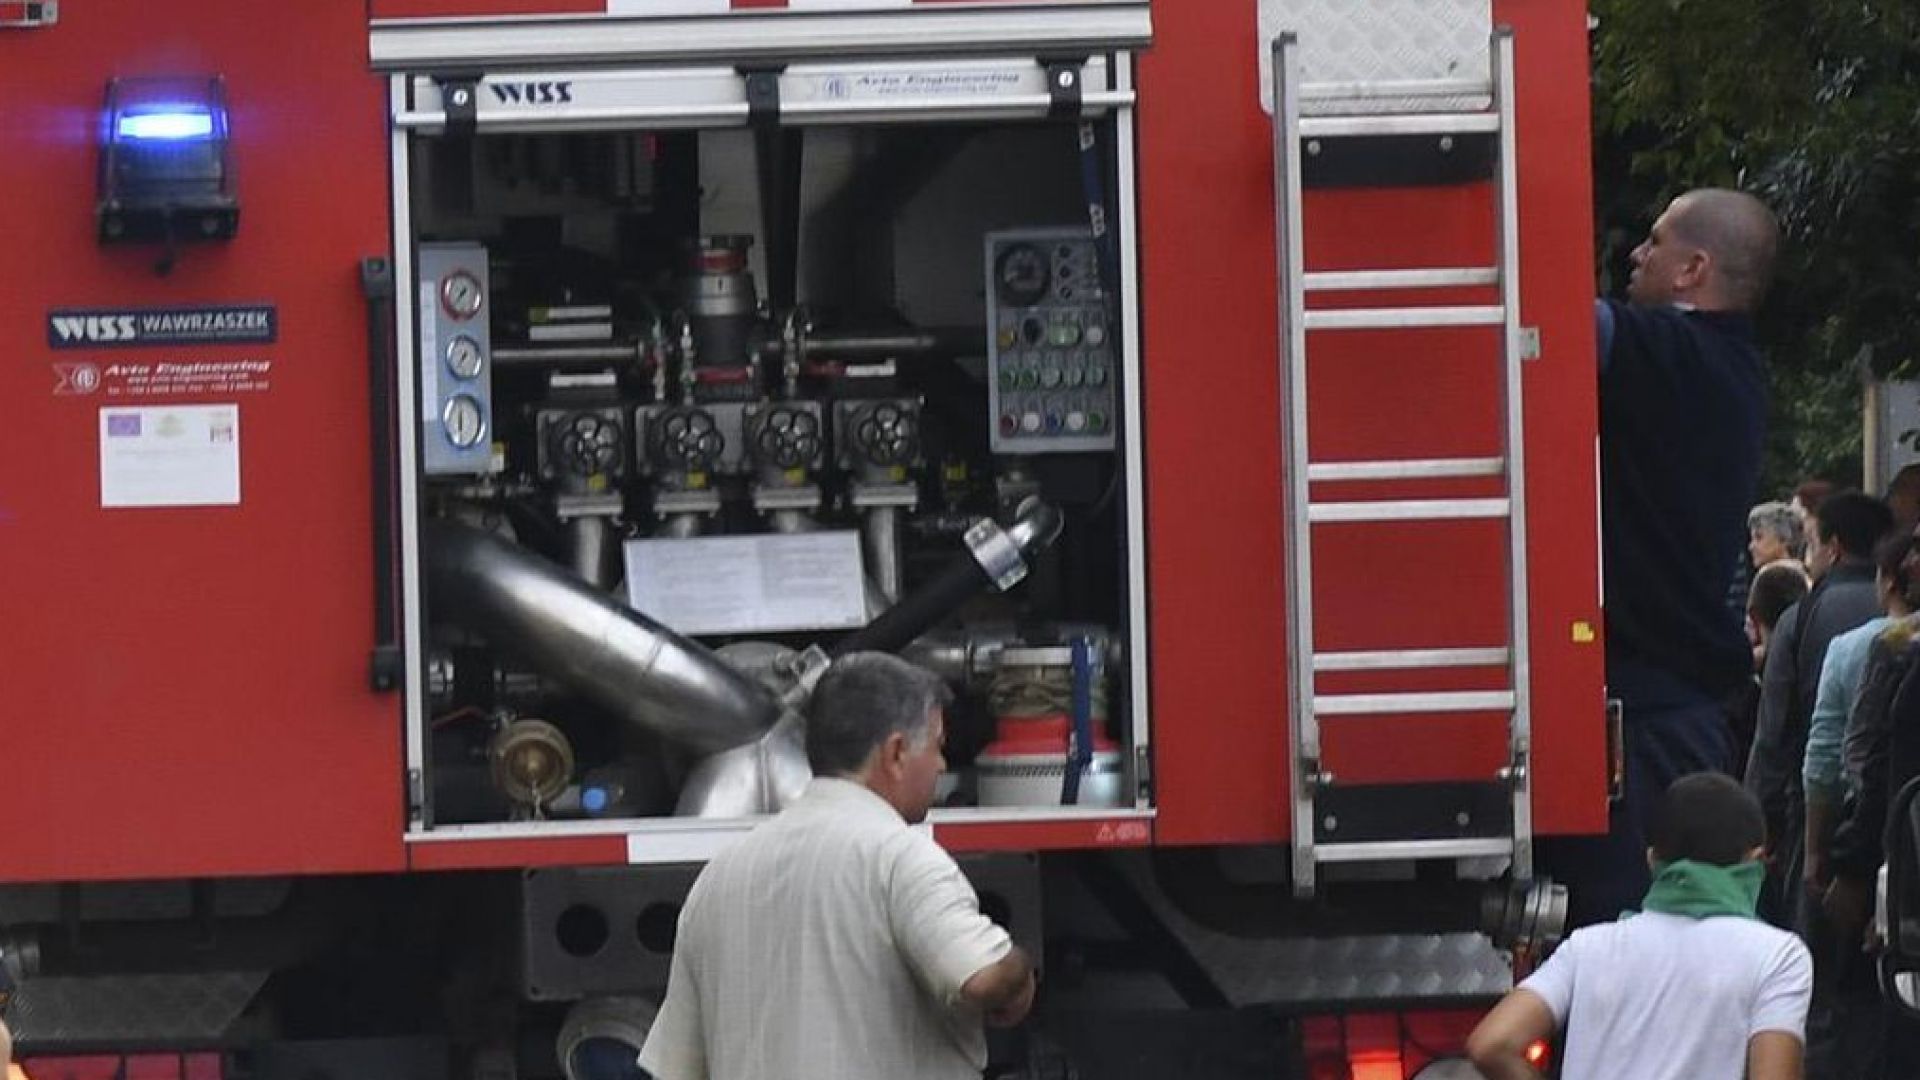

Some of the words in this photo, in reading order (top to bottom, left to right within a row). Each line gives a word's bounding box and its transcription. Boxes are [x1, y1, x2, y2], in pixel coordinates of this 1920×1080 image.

[489, 81, 573, 104] WISS
[52, 315, 136, 341] WISS
[143, 311, 269, 332] WAWRZASZEK
[156, 359, 272, 375] Engineering
